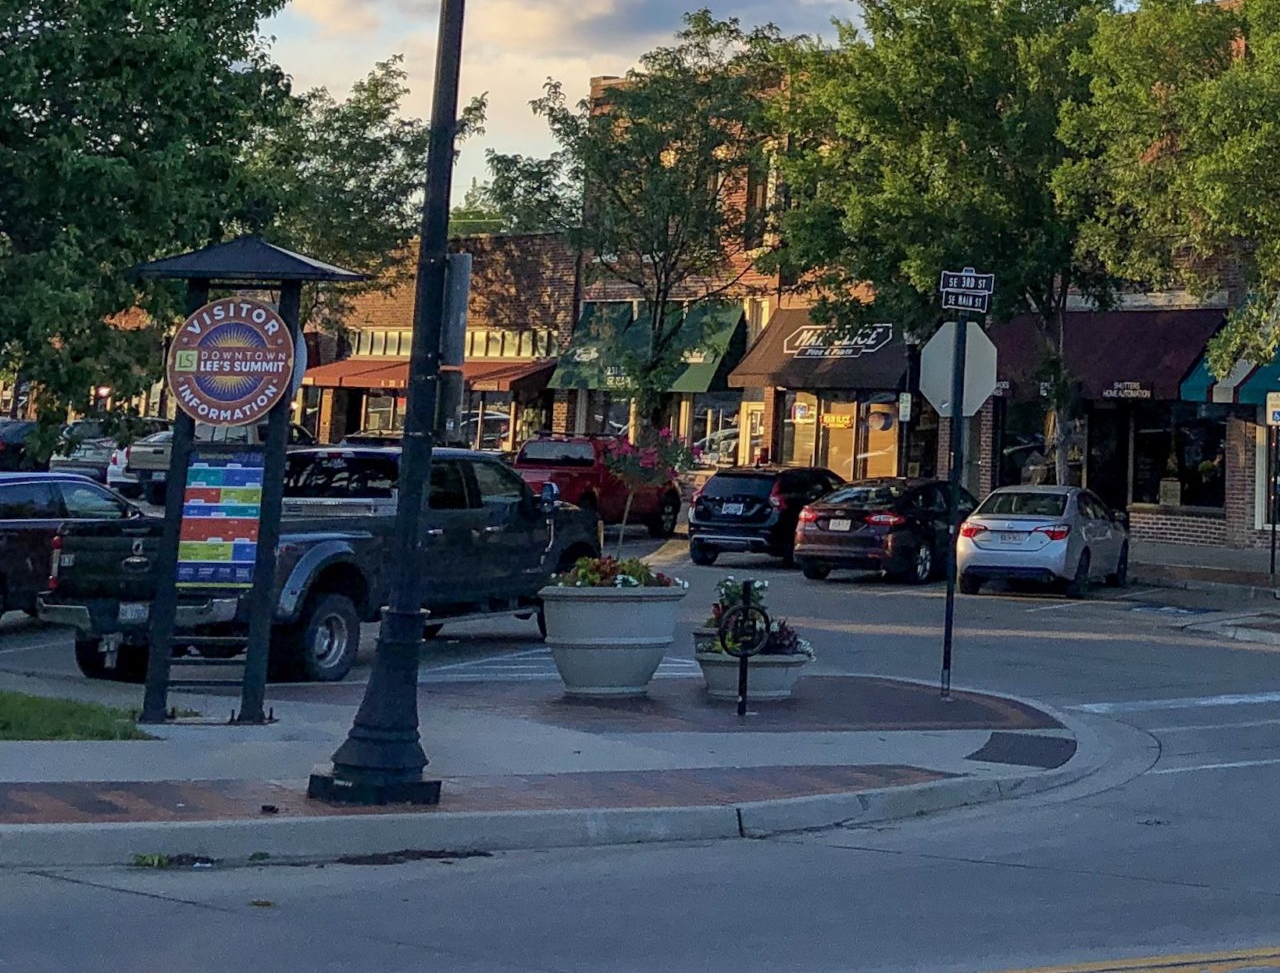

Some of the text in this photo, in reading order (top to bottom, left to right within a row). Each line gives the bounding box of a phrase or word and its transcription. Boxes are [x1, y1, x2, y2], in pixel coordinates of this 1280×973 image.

[949, 276, 986, 289] SE 3RD ST
[948, 294, 982, 308] SE MAIN ST
[186, 303, 280, 336] VISITOR
[179, 353, 194, 369] LS
[200, 351, 286, 361] DOWNTOWN
[200, 361, 285, 373] LEE'S SUMMIT
[178, 384, 278, 421] INFORMATION
